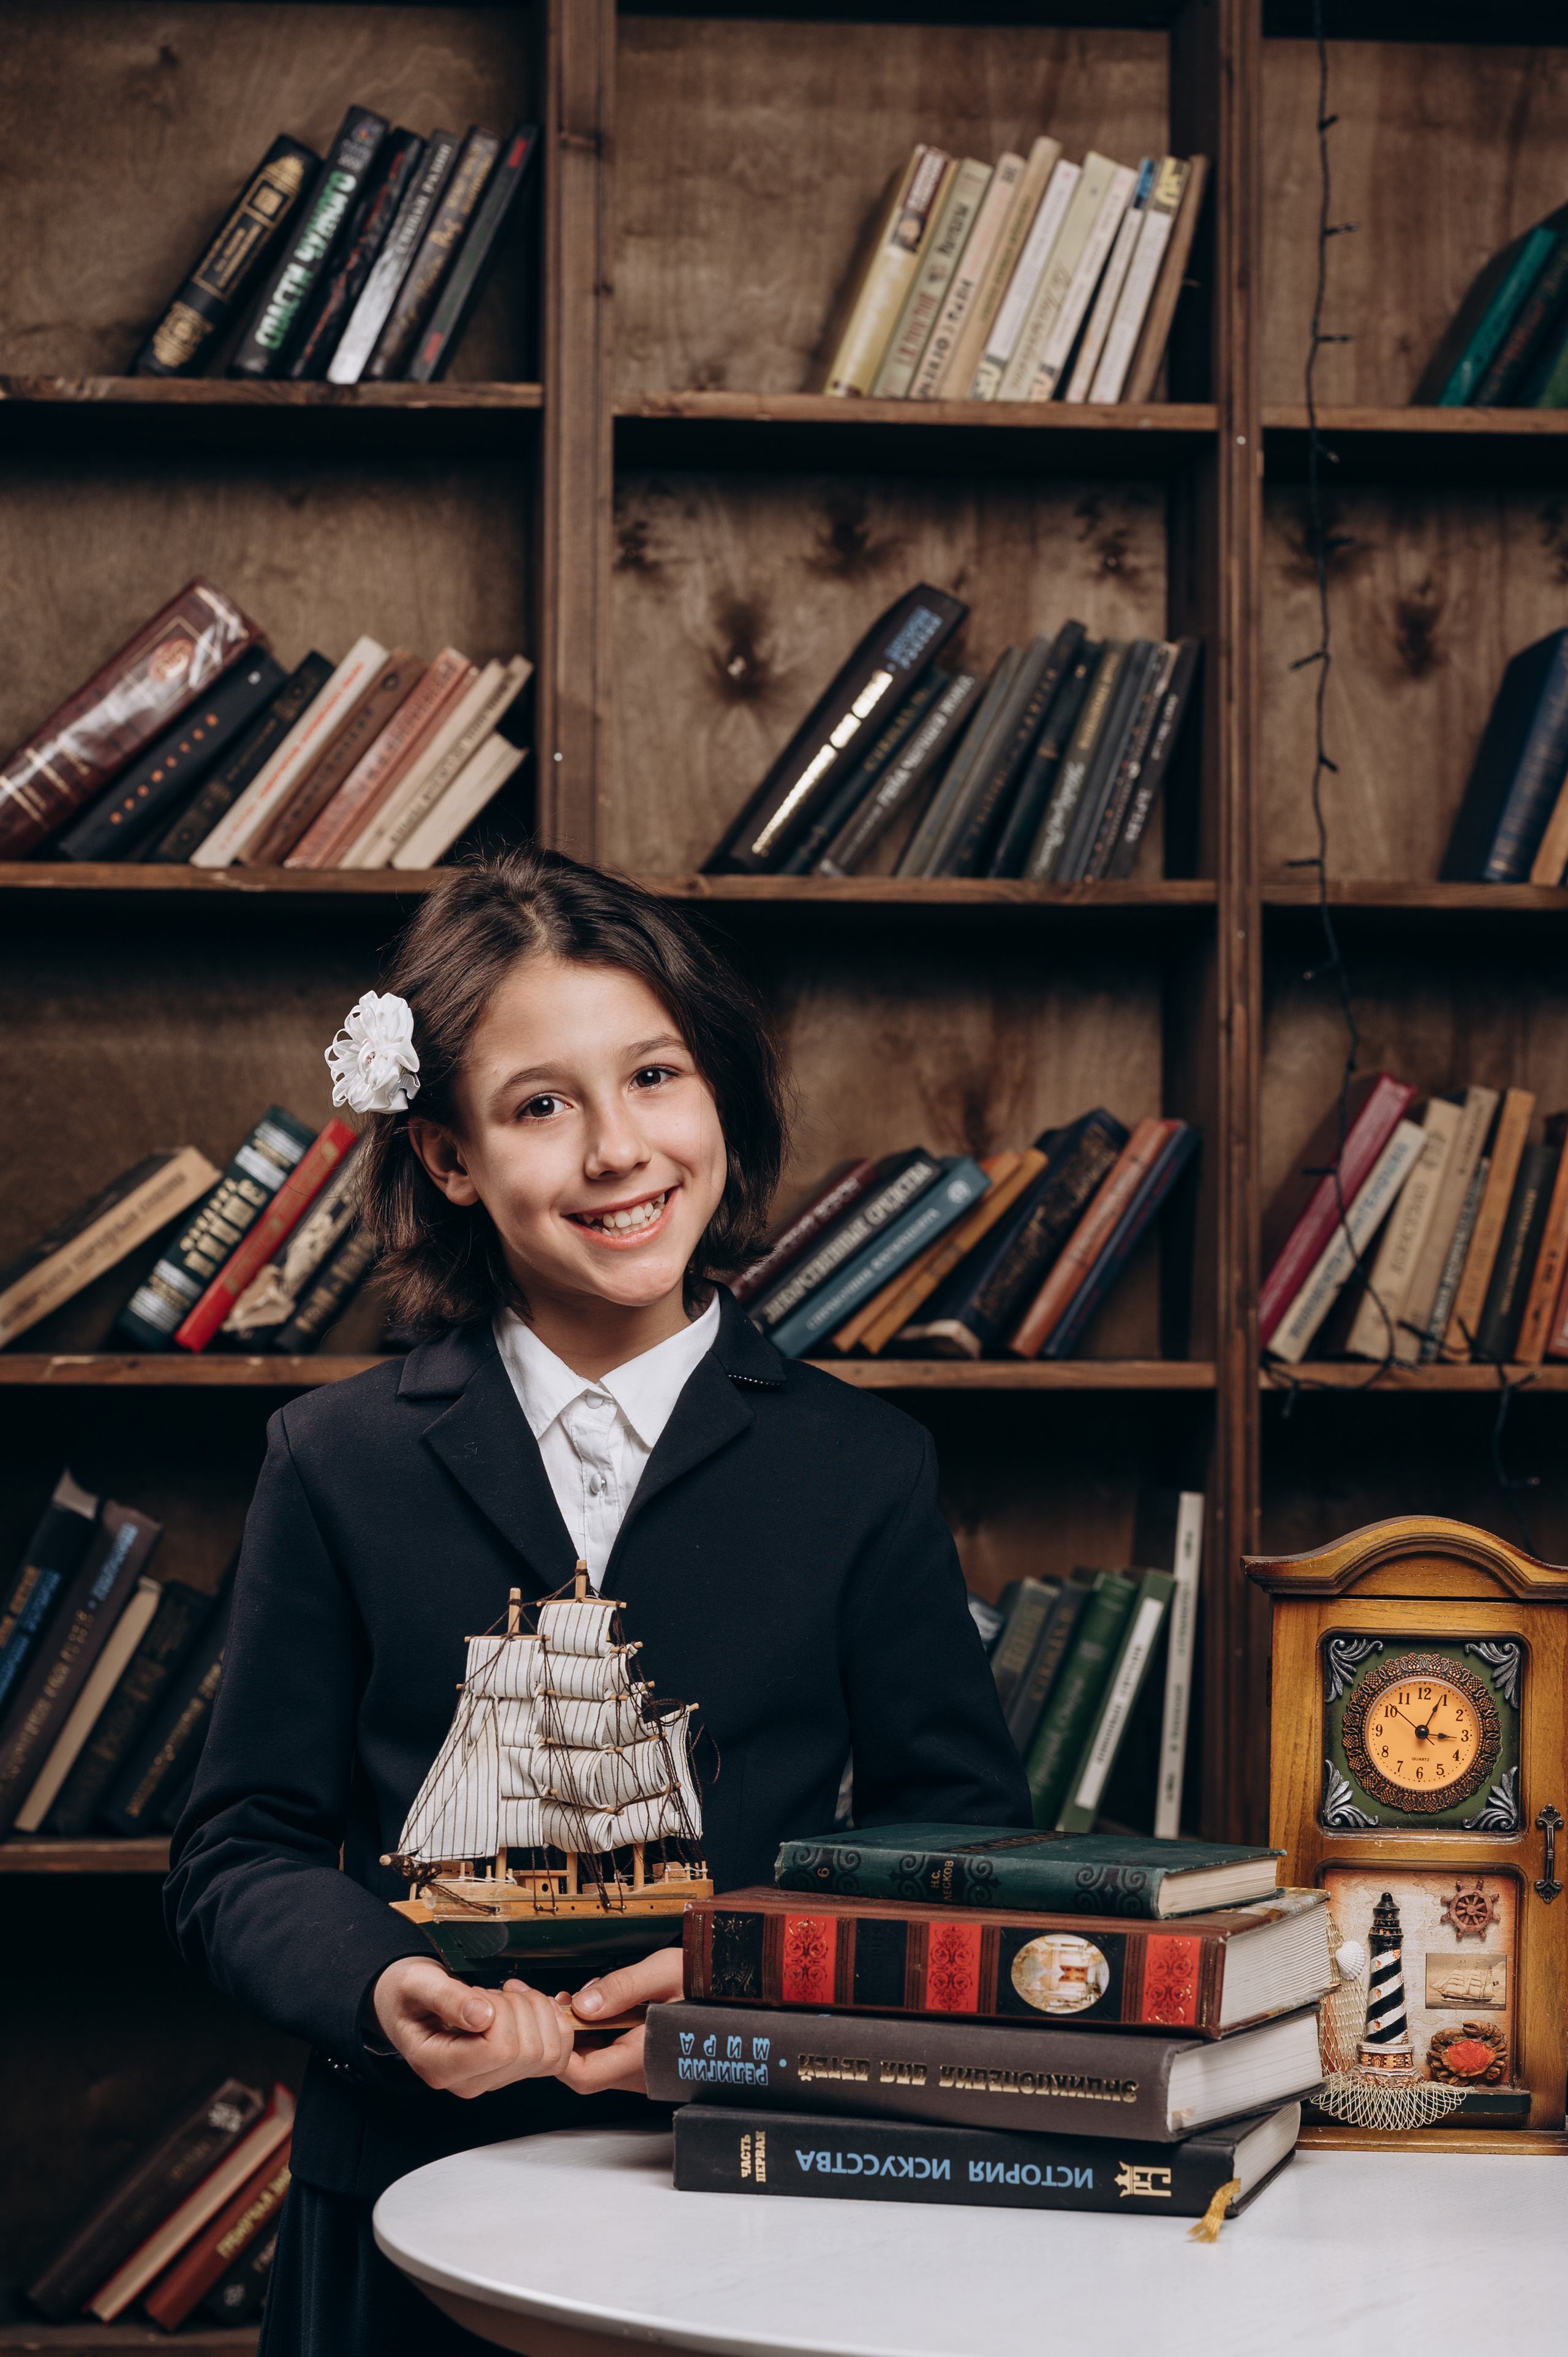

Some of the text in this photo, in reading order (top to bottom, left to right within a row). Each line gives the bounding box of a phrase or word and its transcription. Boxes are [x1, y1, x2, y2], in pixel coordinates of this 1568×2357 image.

[255, 263, 314, 350] СПАСТИ
[295, 170, 357, 262] ЧУЖОГО
[864, 1162, 933, 1224] СРЕДСТВА
[1398, 1692, 1410, 1705] 11
[1417, 1687, 1431, 1700] 12
[1442, 1694, 1448, 1706] 1
[1384, 1705, 1398, 1717] 10
[1456, 1709, 1463, 1722] 2
[1376, 1724, 1383, 1737] 9
[1461, 1730, 1469, 1742] 3
[1381, 1746, 1389, 1758] 8
[1452, 1749, 1460, 1761] 4
[1397, 1760, 1404, 1772] 7
[1416, 1766, 1423, 1779] 6
[1436, 1763, 1444, 1776] 5
[931, 1869, 941, 1889] Н.С.
[943, 1860, 954, 1902] ЛЕСКОВ
[679, 2057, 768, 2086] РЕЛИГИИ
[798, 2053, 1139, 2103] ЭНЦИКЛОПЕДИЯ ДЛЯ ДЕТЕЙ
[741, 2133, 752, 2178] ЧАСТЬ
[755, 2130, 767, 2184] ПЕРВАЯ
[795, 2149, 1094, 2190] ИСТОРИЯ ИСКУССТВА
